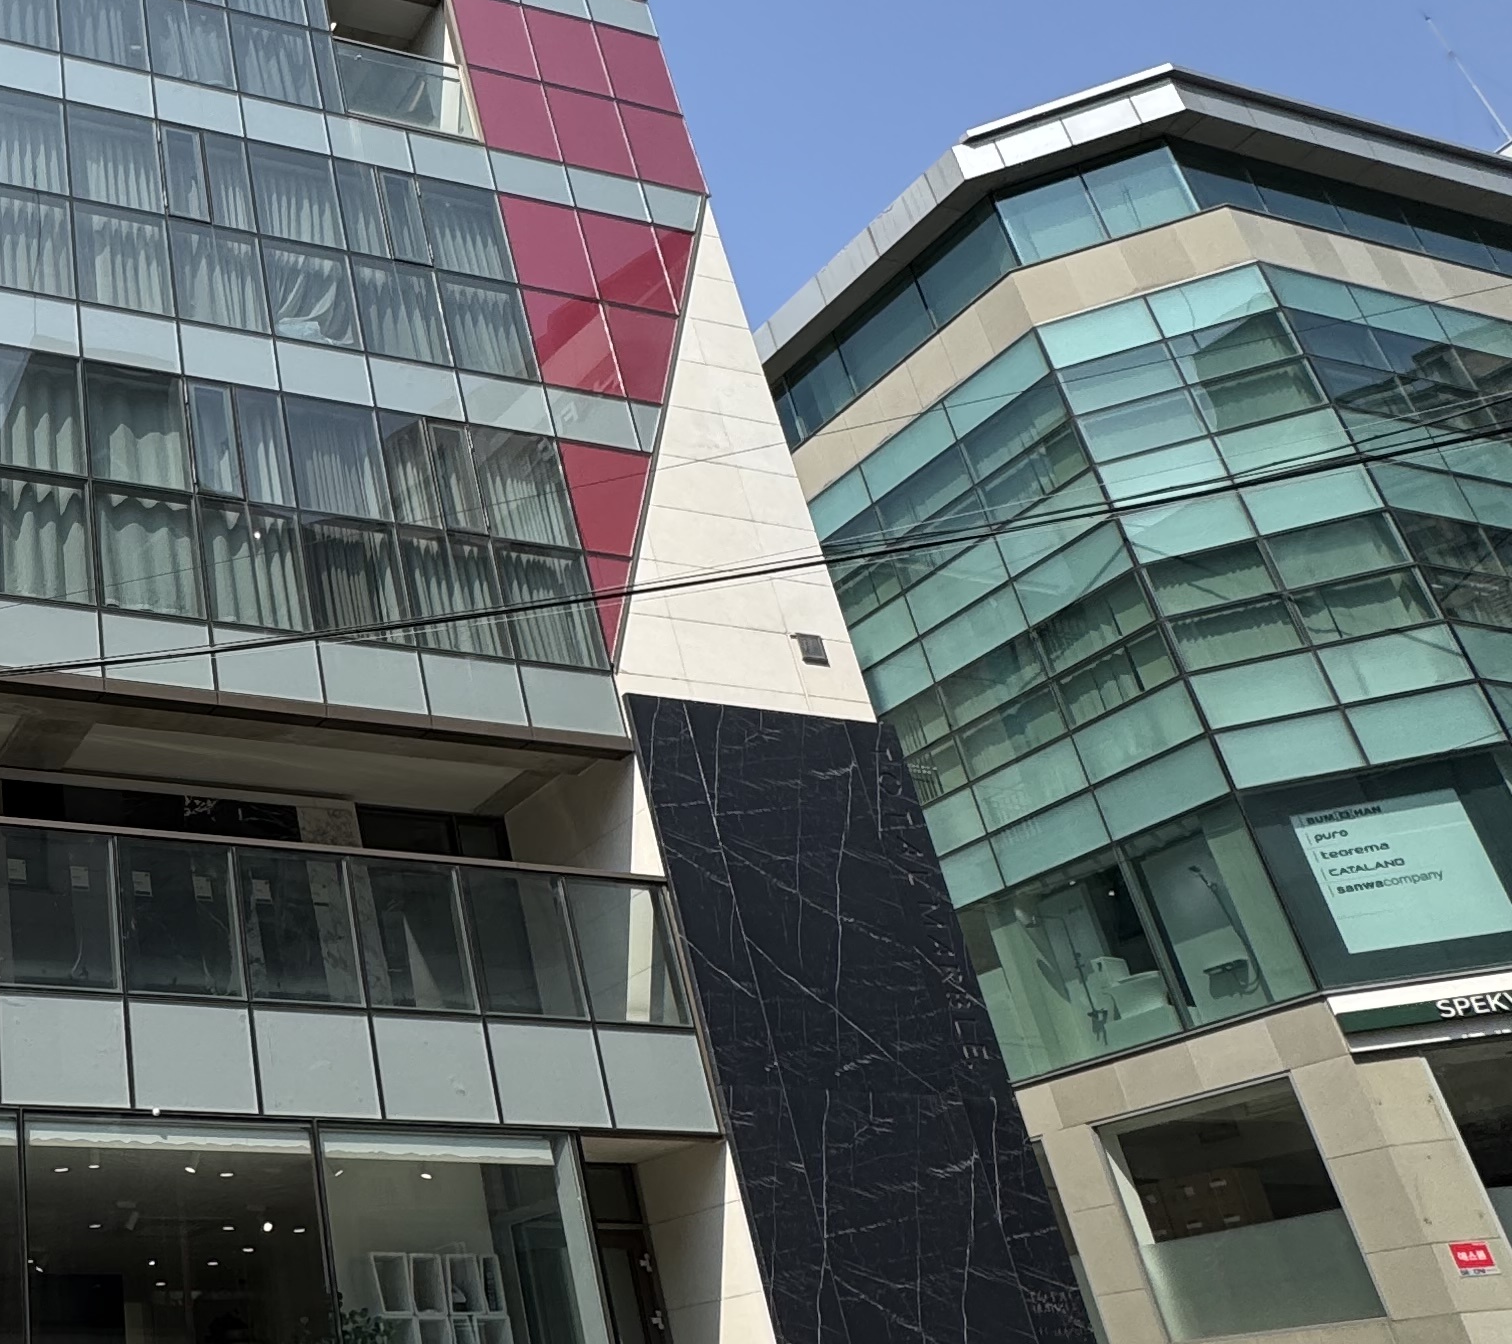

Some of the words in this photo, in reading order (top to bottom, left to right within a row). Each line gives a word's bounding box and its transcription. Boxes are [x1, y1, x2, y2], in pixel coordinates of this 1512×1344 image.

[1313, 829, 1349, 843] puro
[1320, 842, 1391, 860] teorema
[1328, 857, 1406, 877] CATALANO
